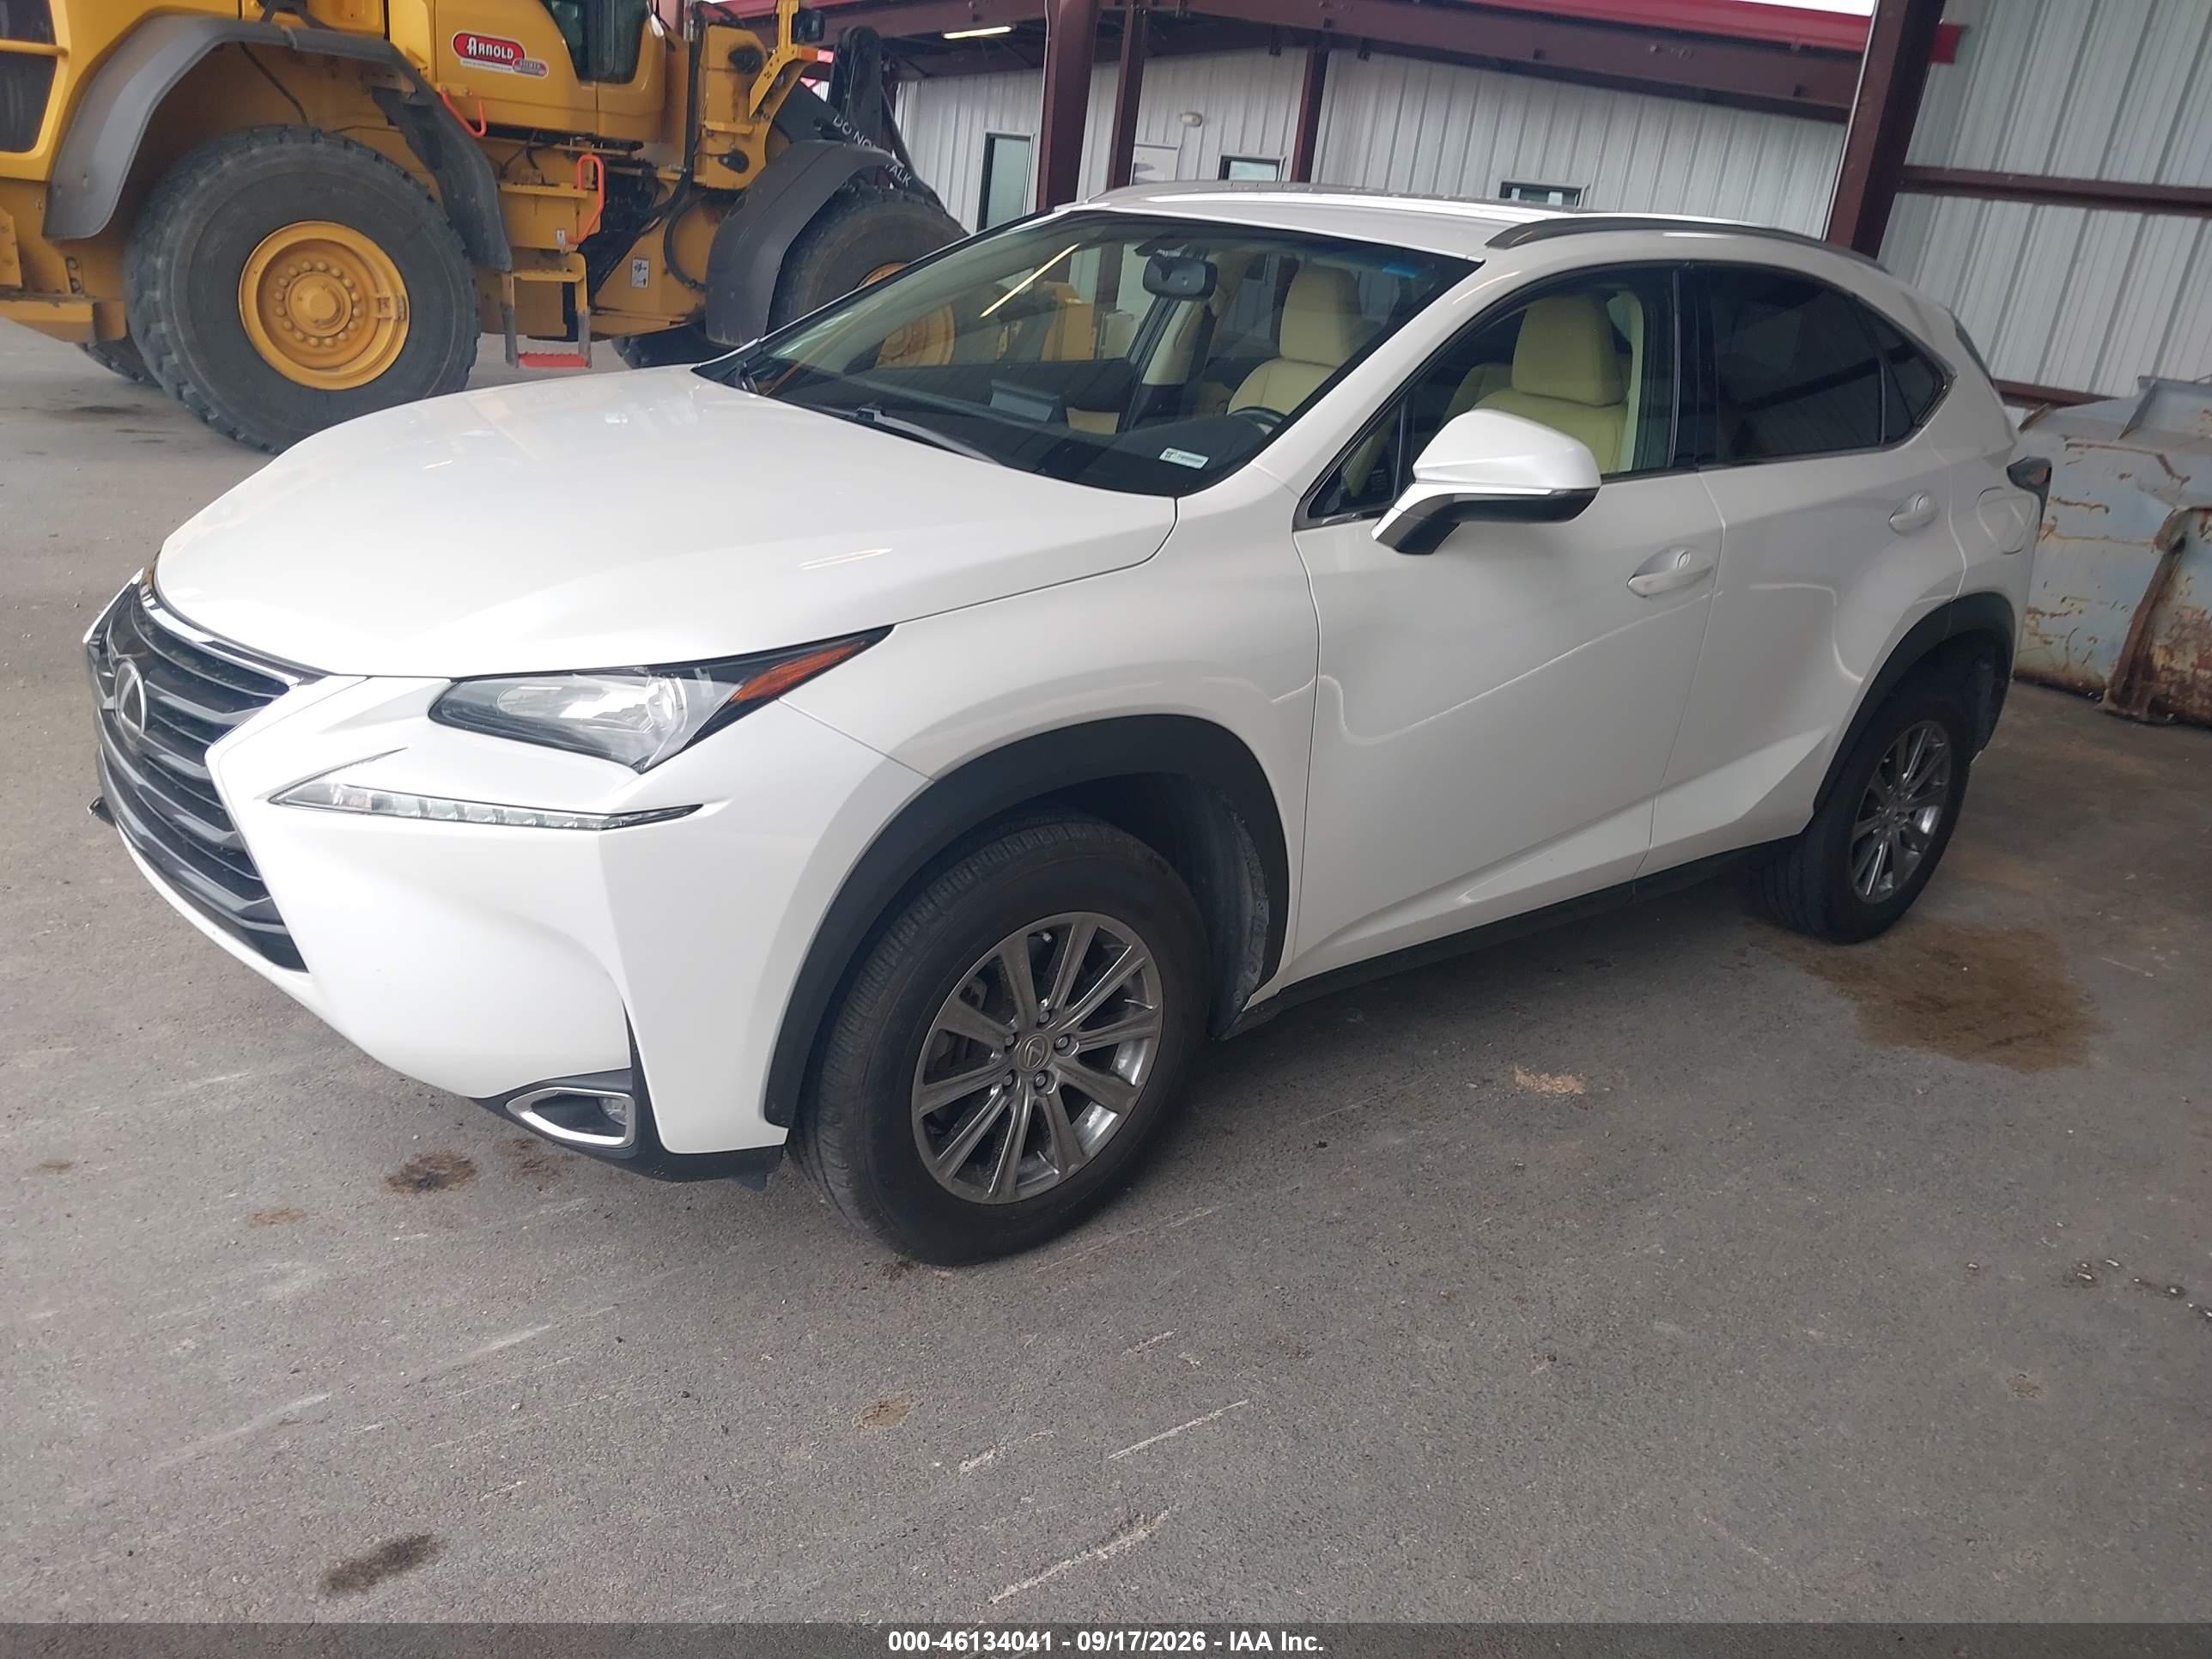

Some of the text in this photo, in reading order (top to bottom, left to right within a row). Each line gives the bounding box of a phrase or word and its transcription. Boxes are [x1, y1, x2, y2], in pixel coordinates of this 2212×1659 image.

[466, 37, 514, 59] ARNOLD
[853, 131, 878, 149] NO
[885, 165, 912, 187] ALK
